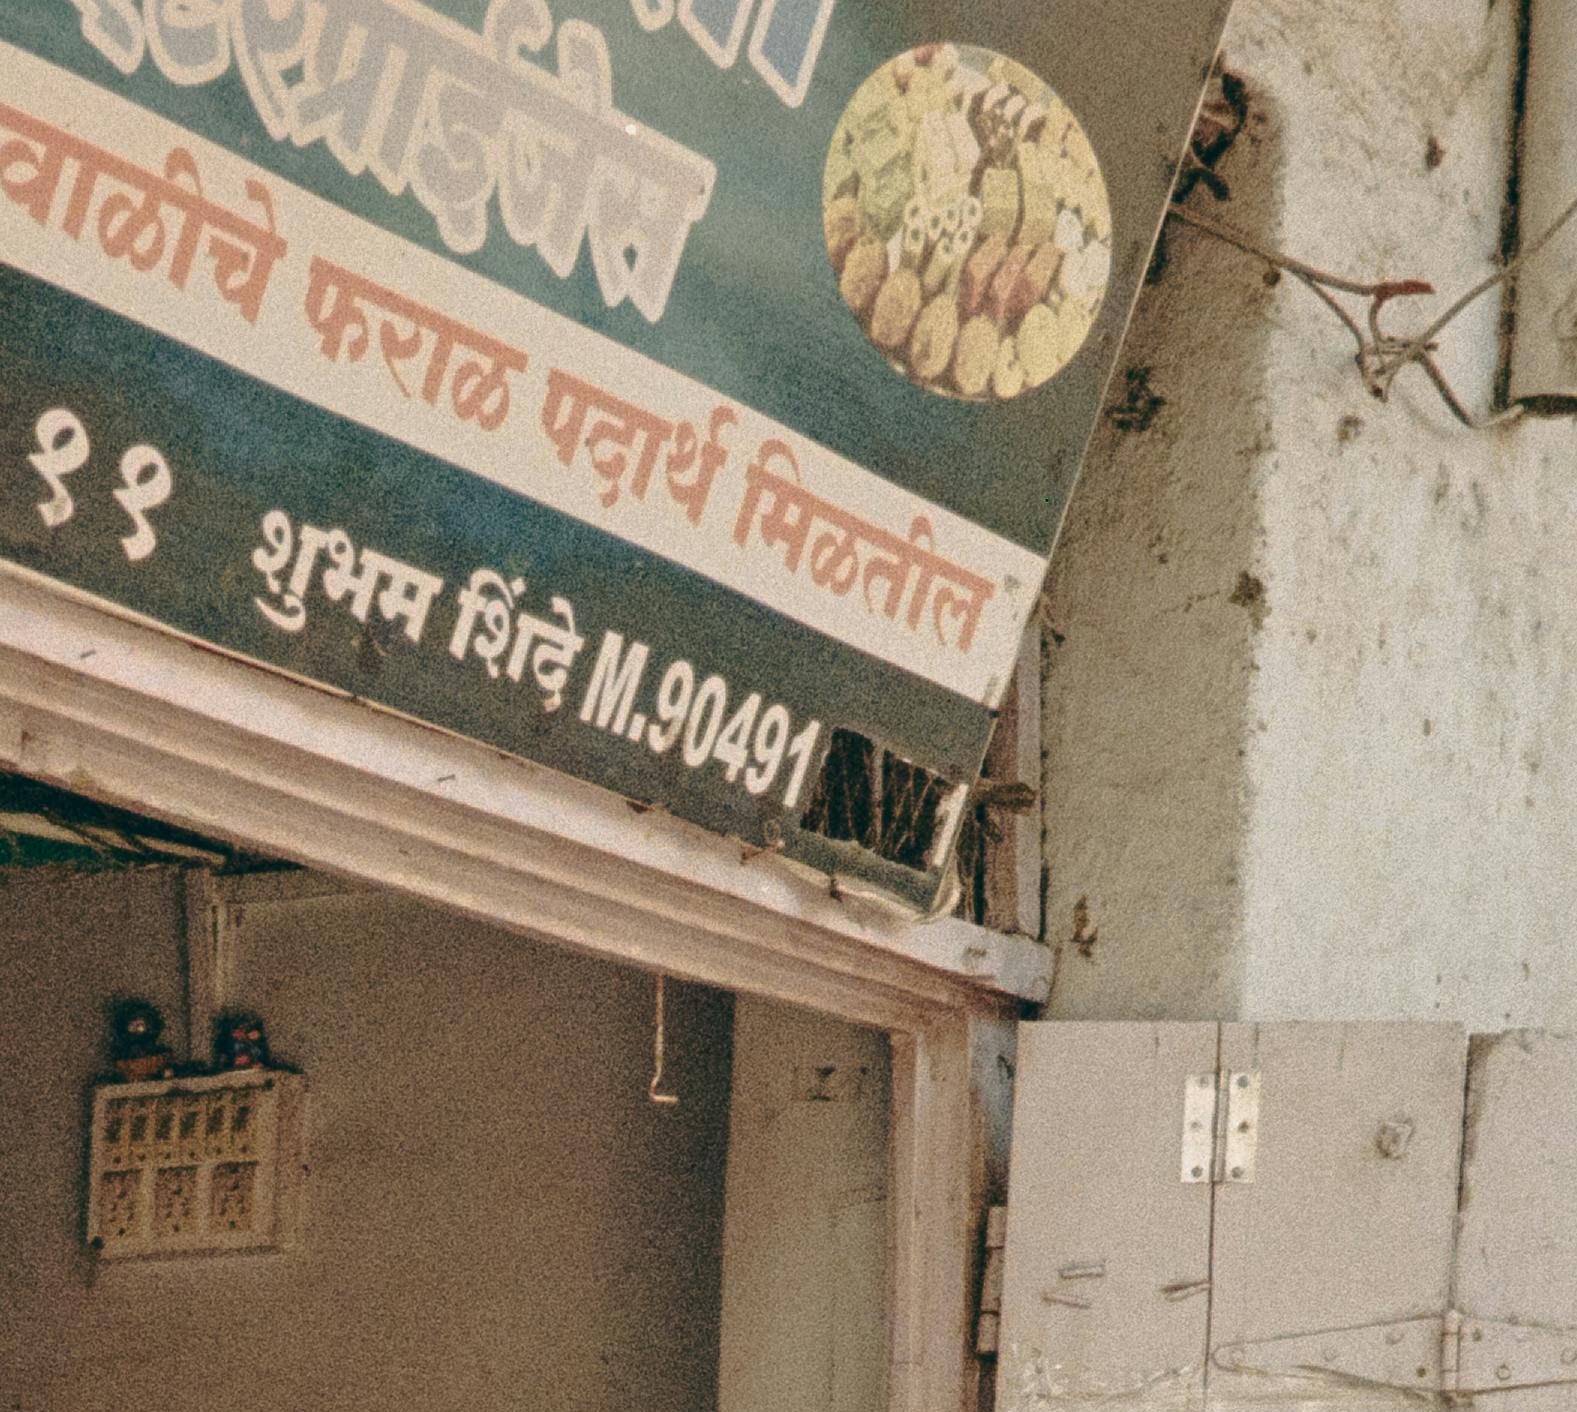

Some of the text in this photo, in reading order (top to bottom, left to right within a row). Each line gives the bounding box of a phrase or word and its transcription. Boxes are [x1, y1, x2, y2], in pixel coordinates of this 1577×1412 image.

[303, 256, 528, 432] फराळ
[540, 368, 741, 528] पदार्थ
[733, 440, 999, 654] मिळतील
[252, 508, 442, 643] शुभम
[448, 566, 582, 709] शिंदे
